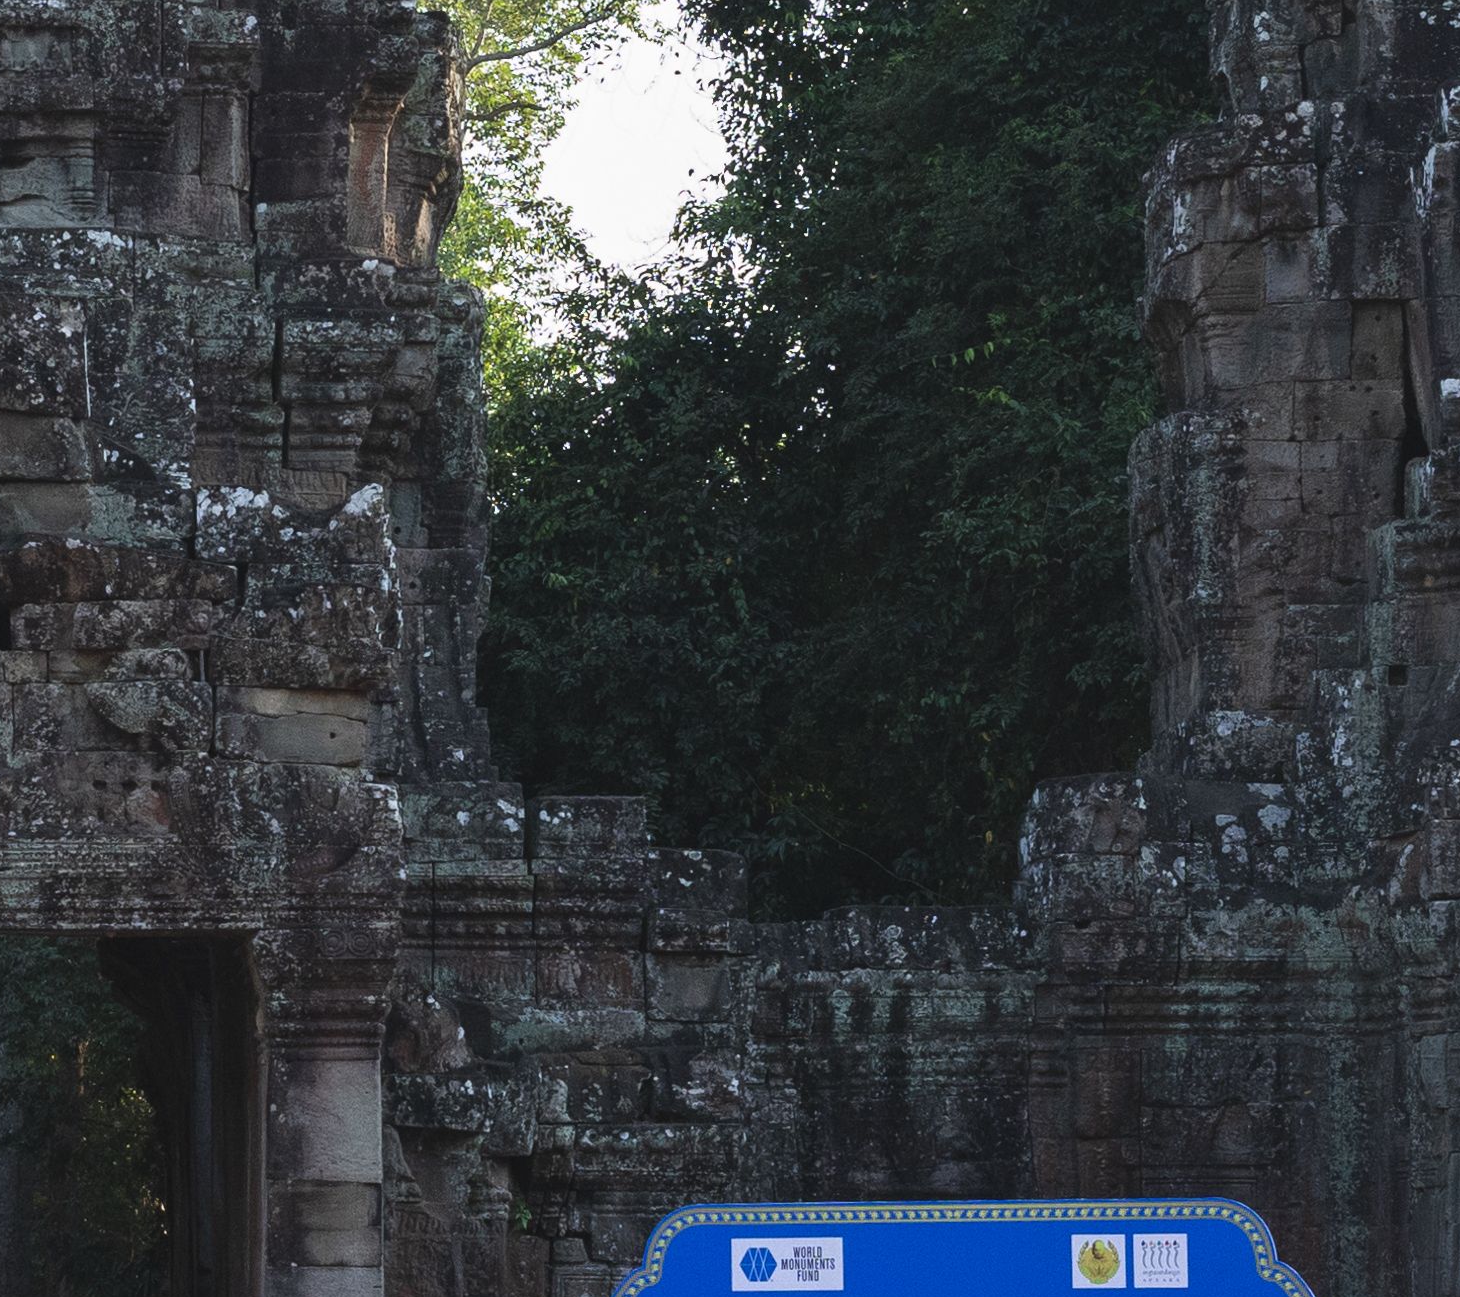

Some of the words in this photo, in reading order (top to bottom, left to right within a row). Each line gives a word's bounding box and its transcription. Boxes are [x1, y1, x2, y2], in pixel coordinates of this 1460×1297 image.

[793, 1246, 822, 1258] WORLD
[781, 1258, 835, 1270] MONUMENTS
[797, 1270, 820, 1282] FUND
